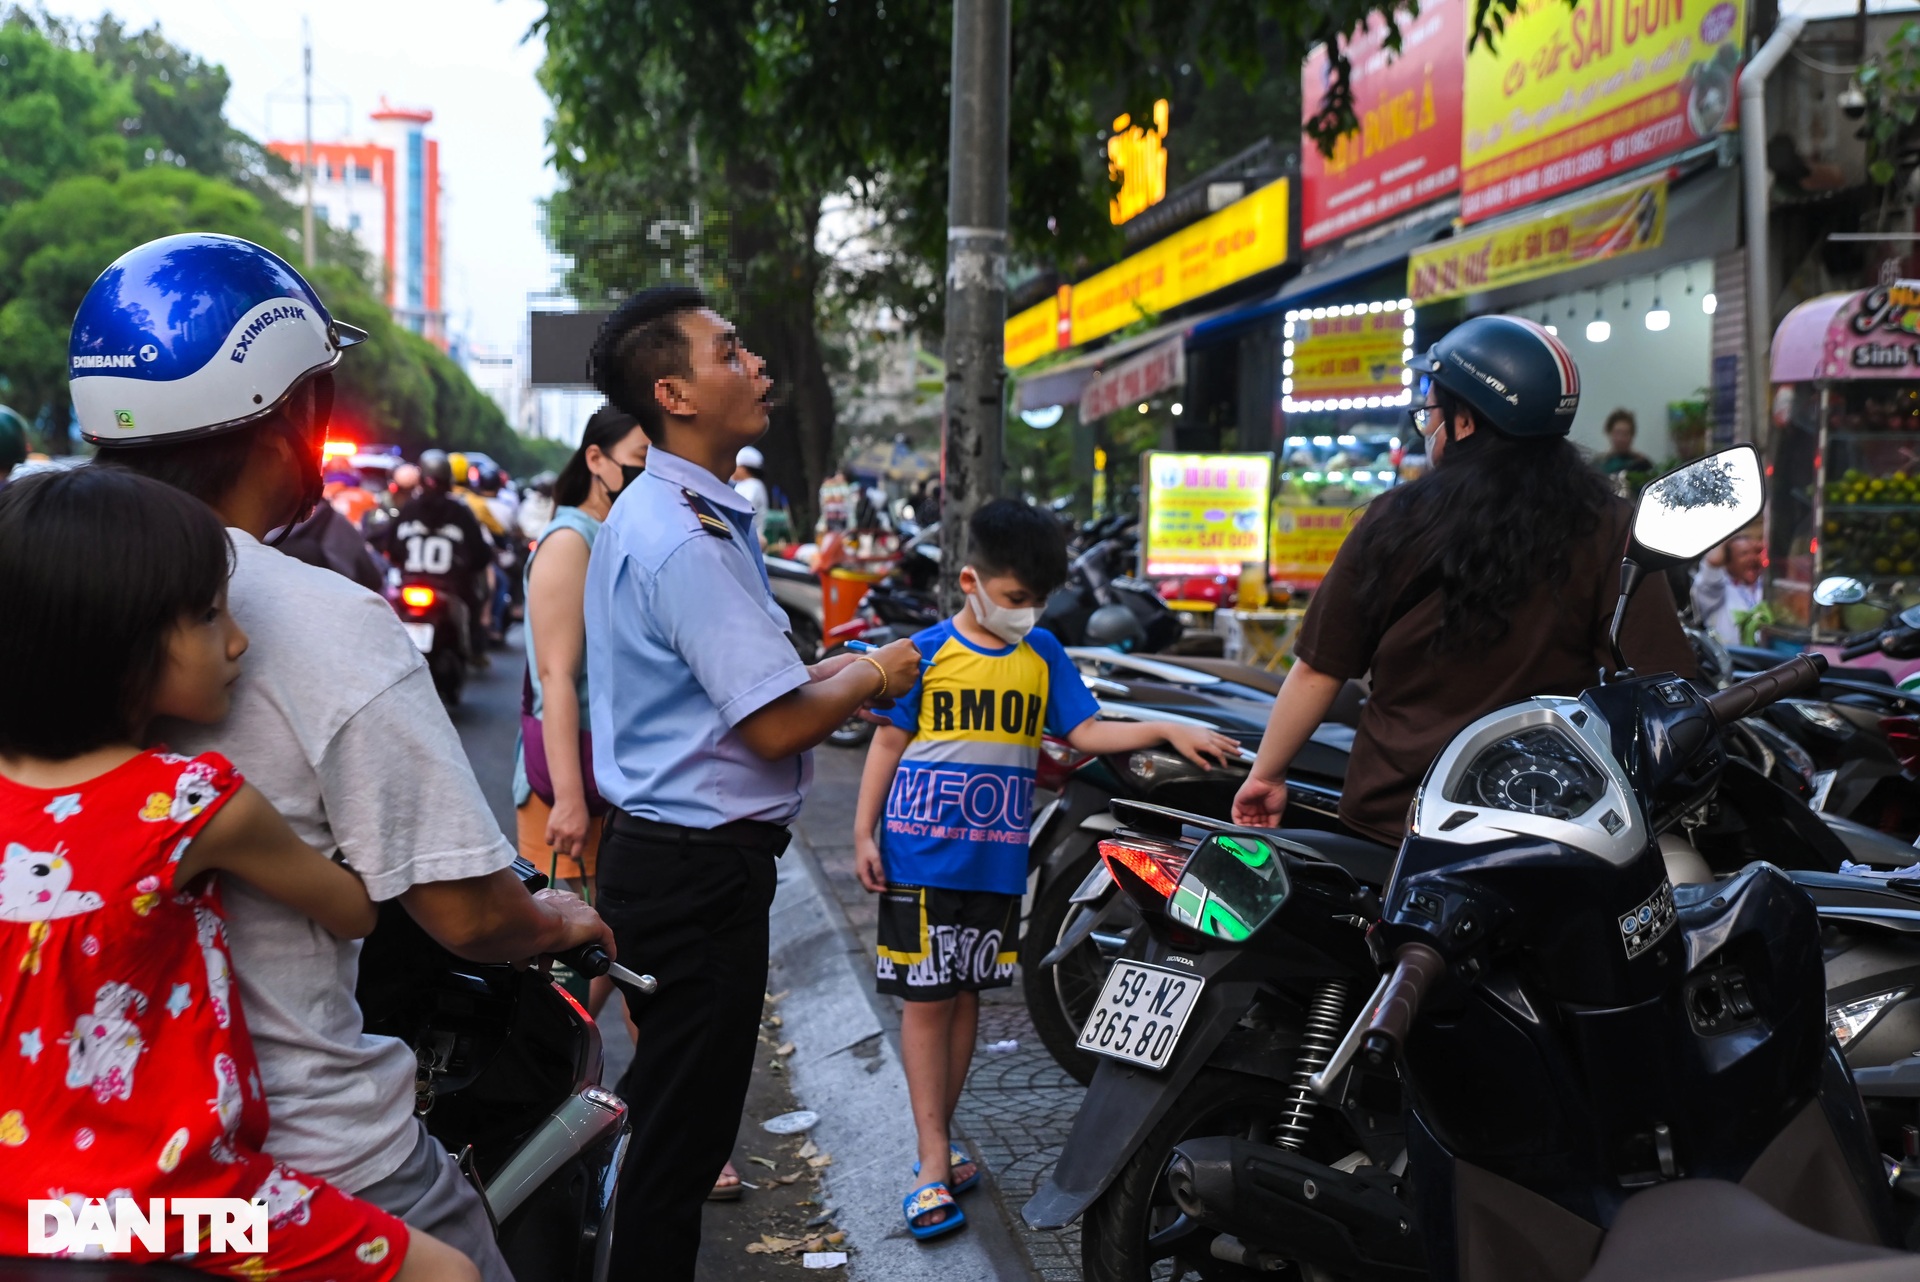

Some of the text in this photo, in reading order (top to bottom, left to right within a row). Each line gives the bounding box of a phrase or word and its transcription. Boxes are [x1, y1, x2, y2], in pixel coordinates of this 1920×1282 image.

[231, 305, 306, 363] EXIMBANK
[72, 354, 136, 369] EXIMBANK
[1855, 343, 1907, 366] Sinh
[404, 534, 453, 575] 10
[886, 819, 930, 837] PIRACY
[930, 824, 968, 839] MUST
[969, 829, 986, 841] BE
[1166, 955, 1195, 967] HONDA
[1085, 1008, 1174, 1061] 365.80
